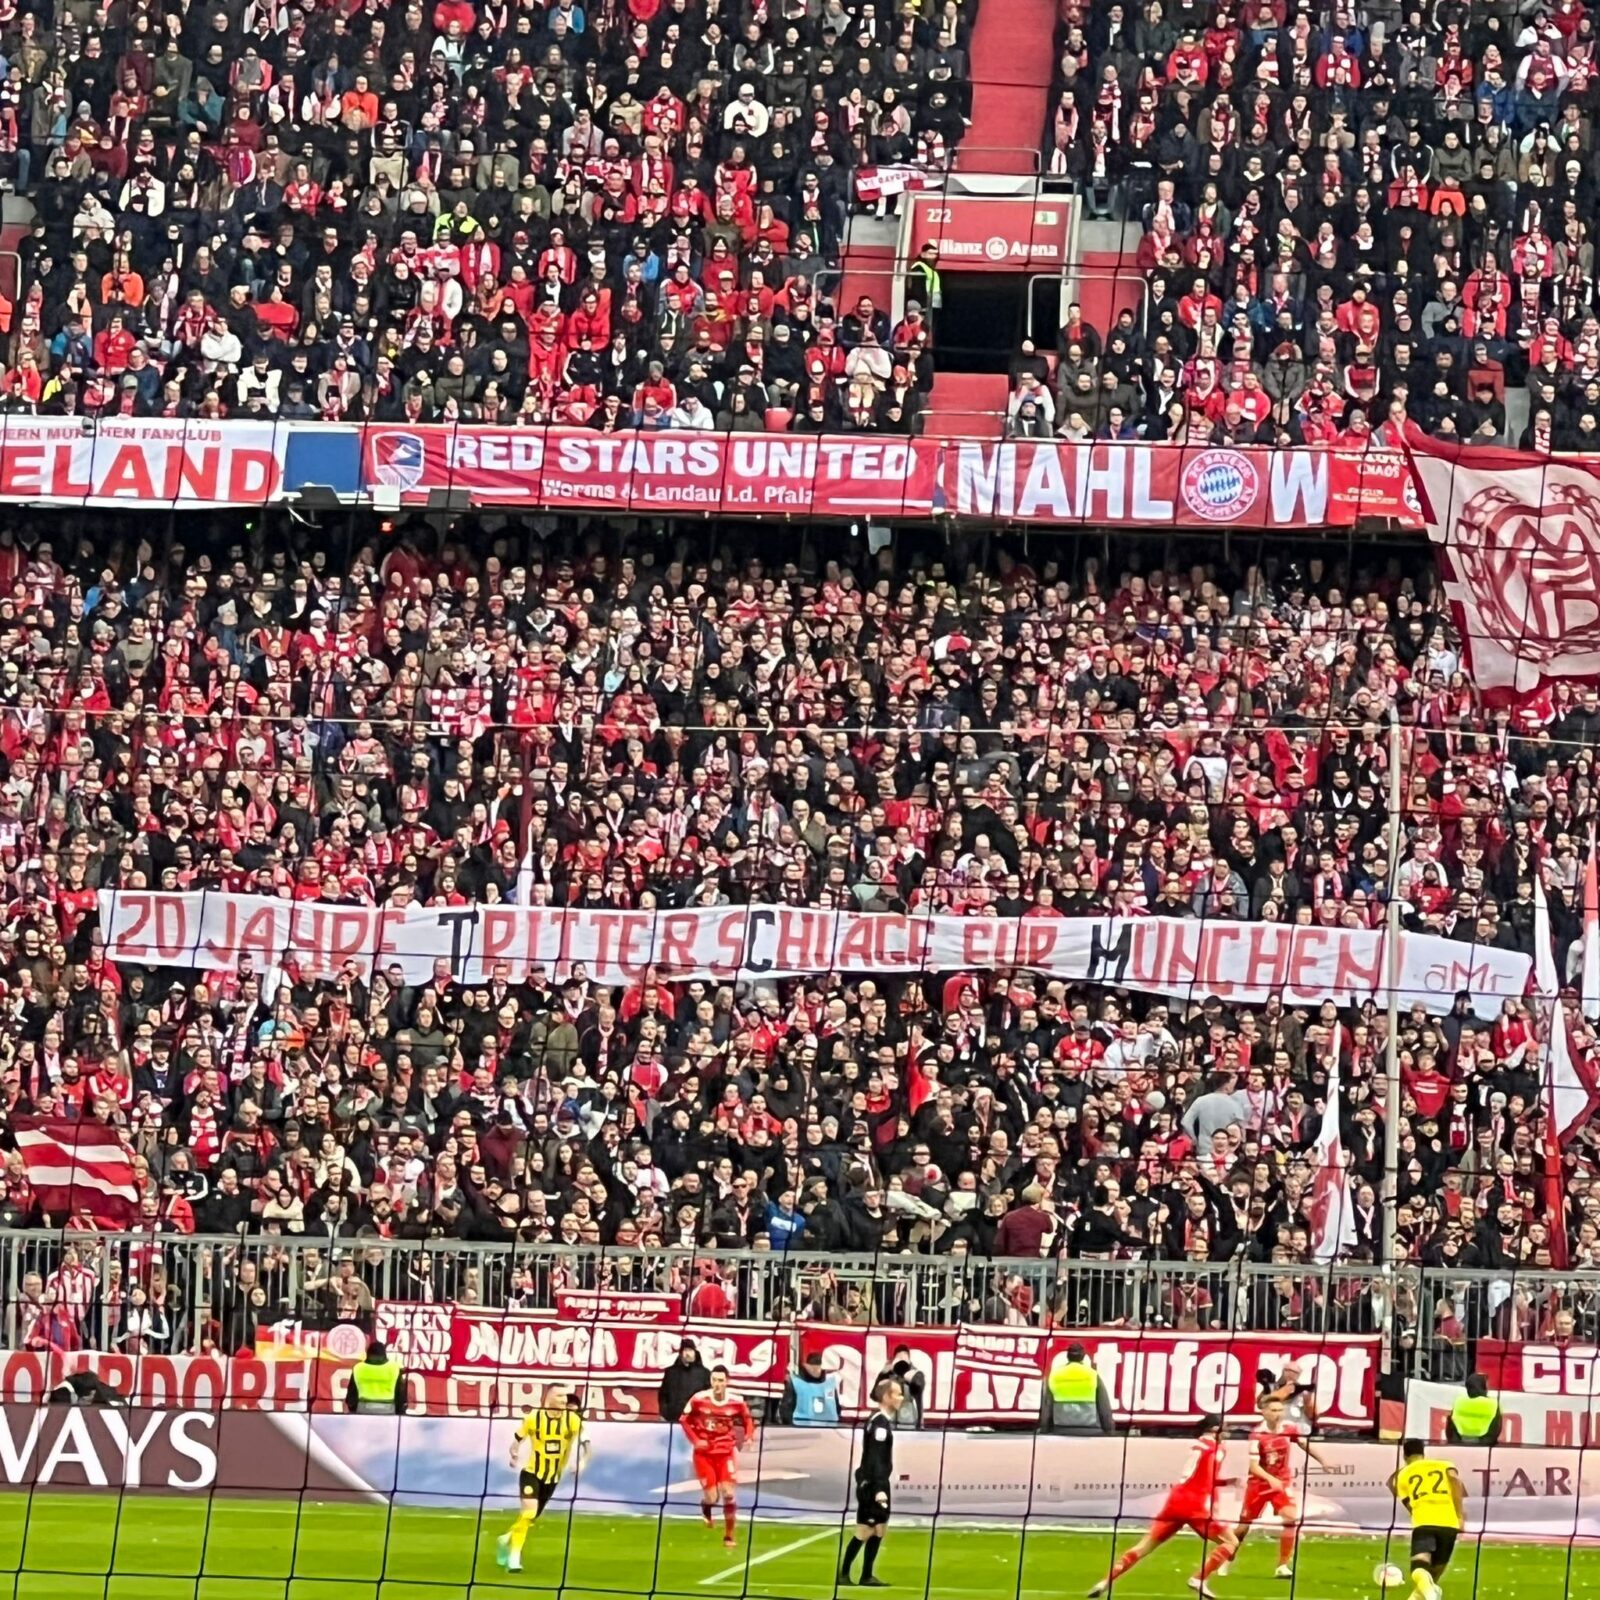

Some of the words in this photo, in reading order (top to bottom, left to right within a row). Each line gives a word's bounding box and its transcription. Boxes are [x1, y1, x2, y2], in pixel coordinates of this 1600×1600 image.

[926, 208, 952, 223] 222
[1010, 241, 1058, 257] Arena
[47, 427, 136, 440] MUNHEN
[142, 427, 222, 441] FANCLUB
[446, 435, 544, 471] RED
[558, 440, 720, 476] STARS
[732, 442, 916, 480] UNITED
[0, 445, 280, 503] ELAND
[956, 442, 1173, 519] MAHL
[1268, 450, 1327, 524] W
[542, 479, 616, 498] Worms
[644, 482, 721, 502] Landau
[765, 486, 815, 504] Pfalz
[116, 895, 187, 960] 20
[376, 1303, 454, 1330] SEEN
[376, 1329, 452, 1354] LAND
[632, 1331, 777, 1377] REELS
[386, 1353, 451, 1371] RONT
[1408, 1470, 1449, 1501] 22
[1461, 1466, 1573, 1498] TAR
